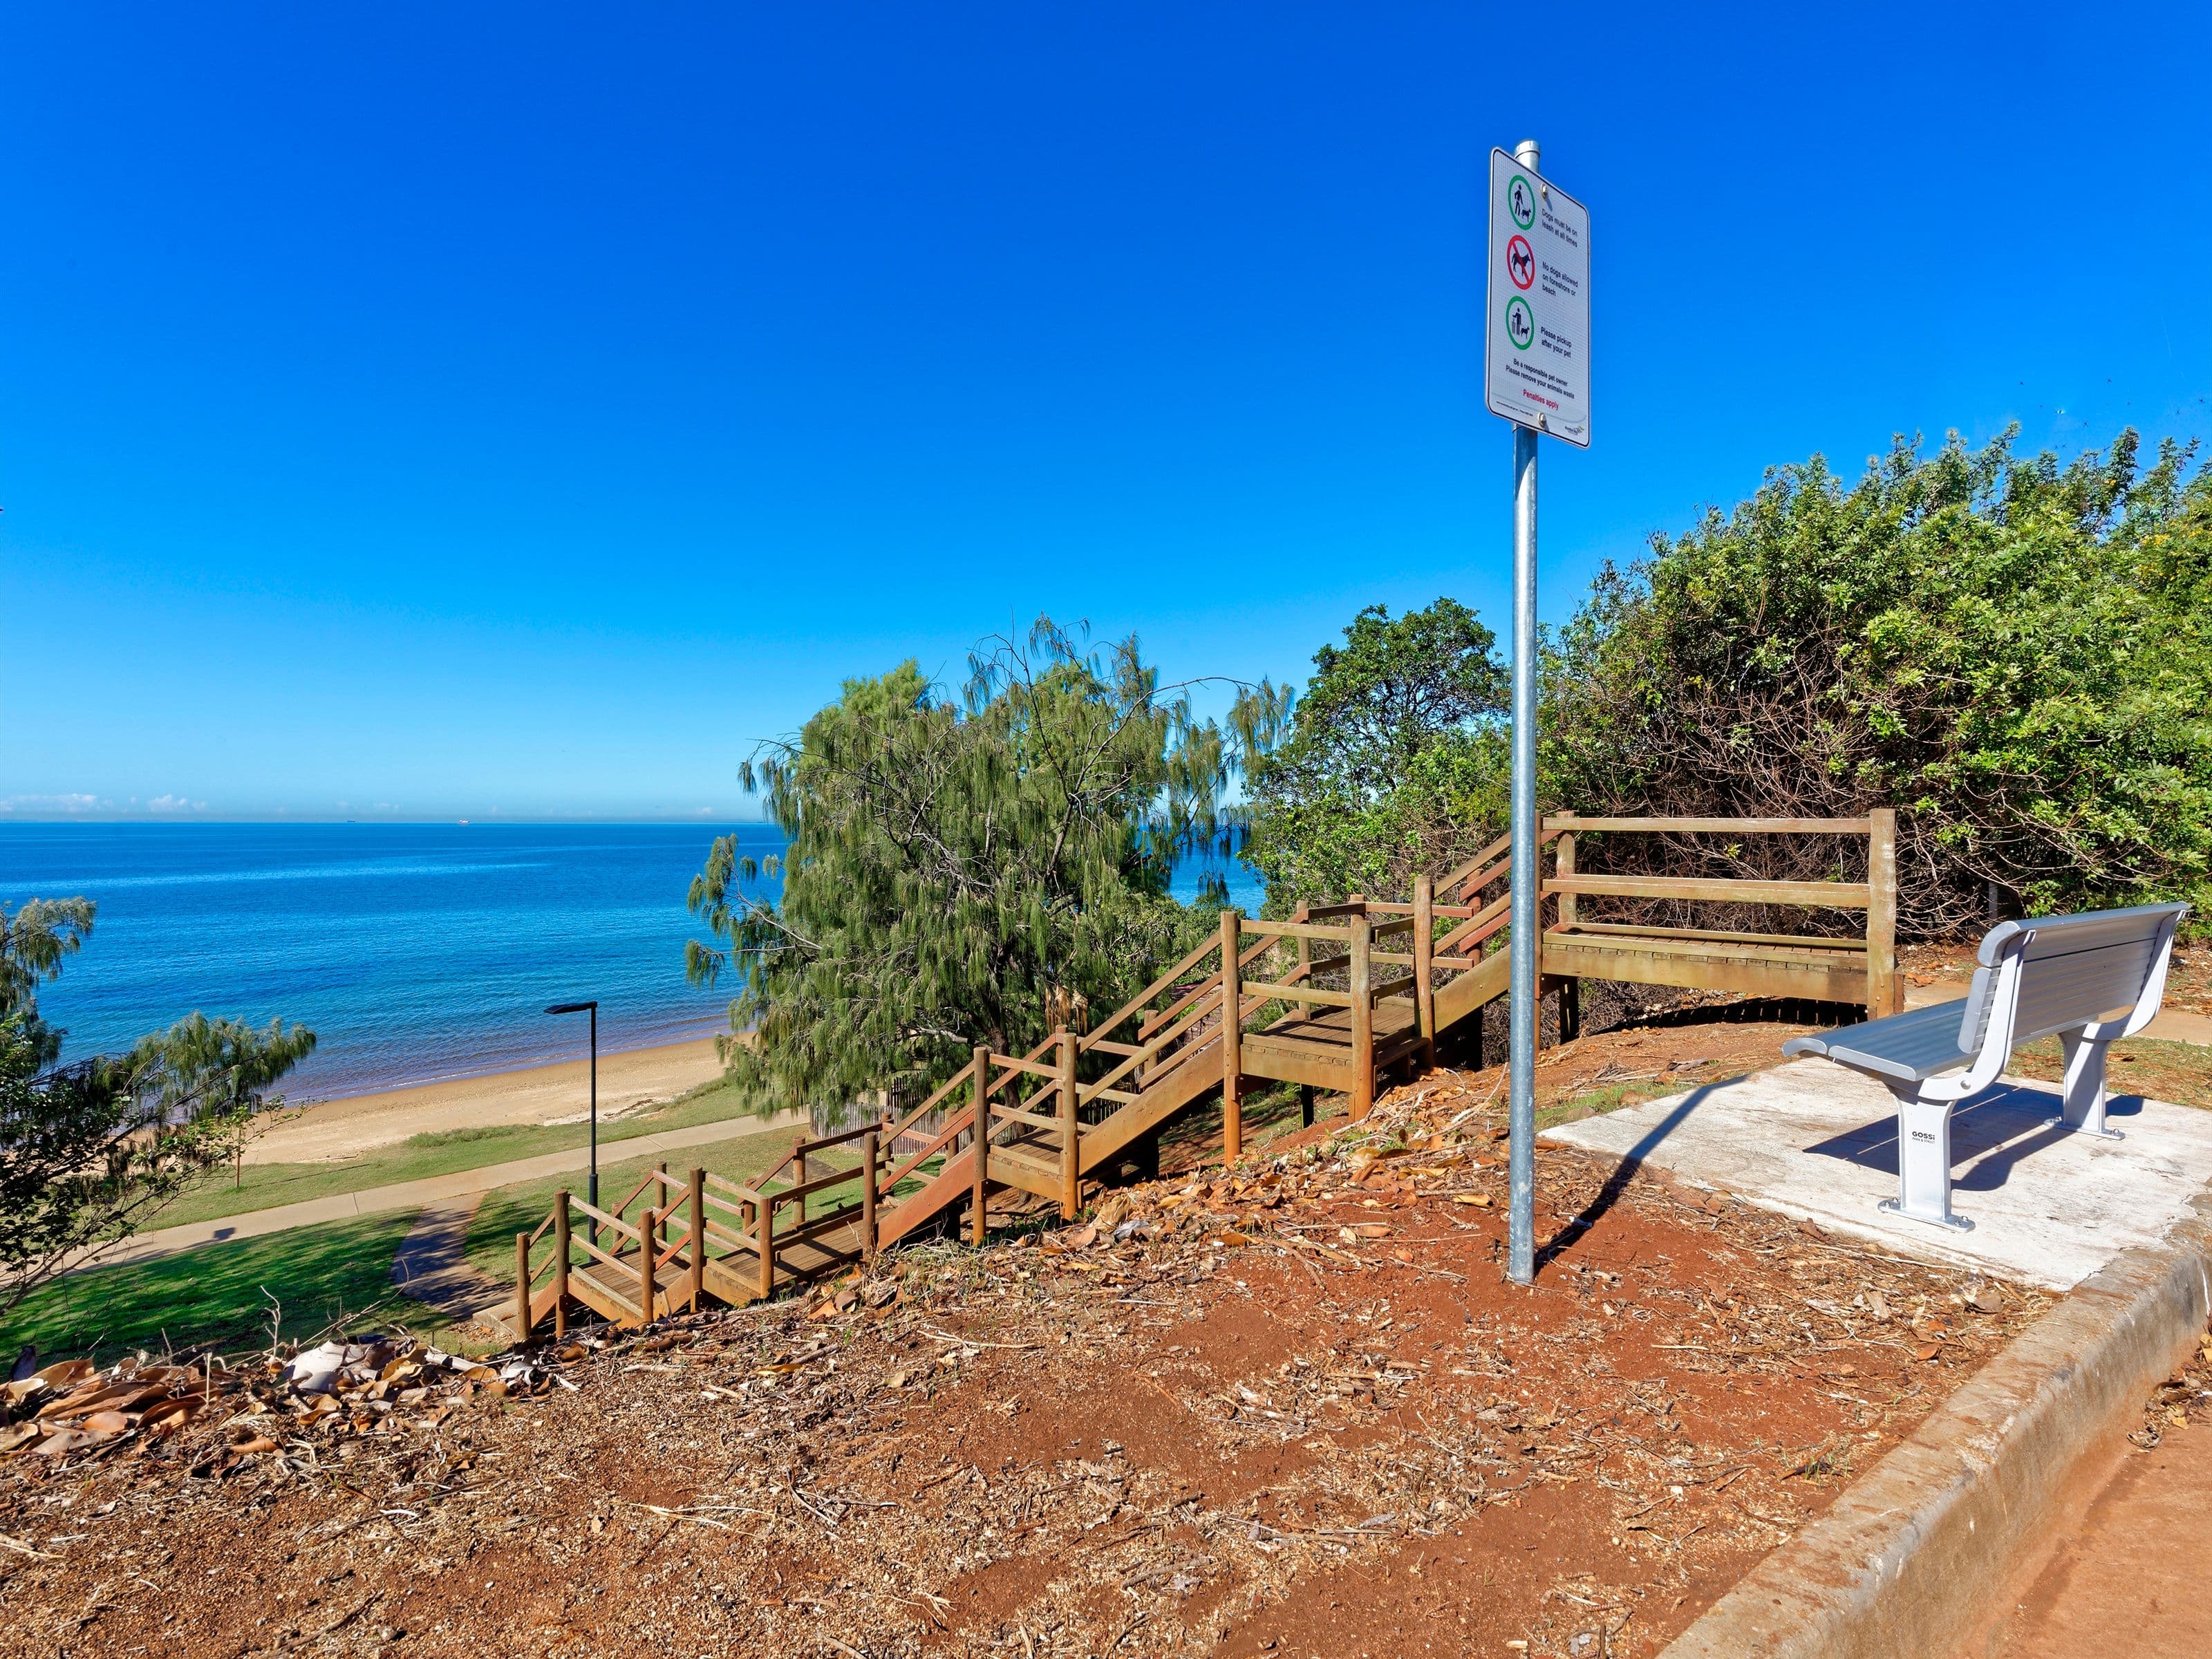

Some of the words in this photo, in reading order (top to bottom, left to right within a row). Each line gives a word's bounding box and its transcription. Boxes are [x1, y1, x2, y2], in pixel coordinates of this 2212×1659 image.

[1541, 208, 1553, 222] Dogs
[1555, 218, 1565, 229] must
[1566, 223, 1571, 233] be
[1542, 219, 1554, 233] leash
[1566, 234, 1577, 247] times
[1542, 261, 1549, 270] No
[1550, 267, 1561, 278] dogs
[1562, 274, 1578, 288] allowed
[1542, 274, 1548, 282] on
[1549, 276, 1570, 294] foreshore
[1542, 283, 1556, 297] beach
[1541, 326, 1556, 340] Please
[1557, 335, 1572, 348] pickup
[1541, 339, 1552, 349] after
[1553, 344, 1563, 354] your
[1506, 364, 1520, 377] Please
[1521, 372, 1536, 383] remove
[1537, 379, 1546, 387] your
[1547, 383, 1562, 394] animals
[1563, 390, 1575, 399] waste
[1513, 358, 1519, 366] Be
[1524, 364, 1548, 378] responsible
[1555, 377, 1568, 386] owner
[1523, 388, 1545, 404] Penalties
[1546, 400, 1559, 411] apply
